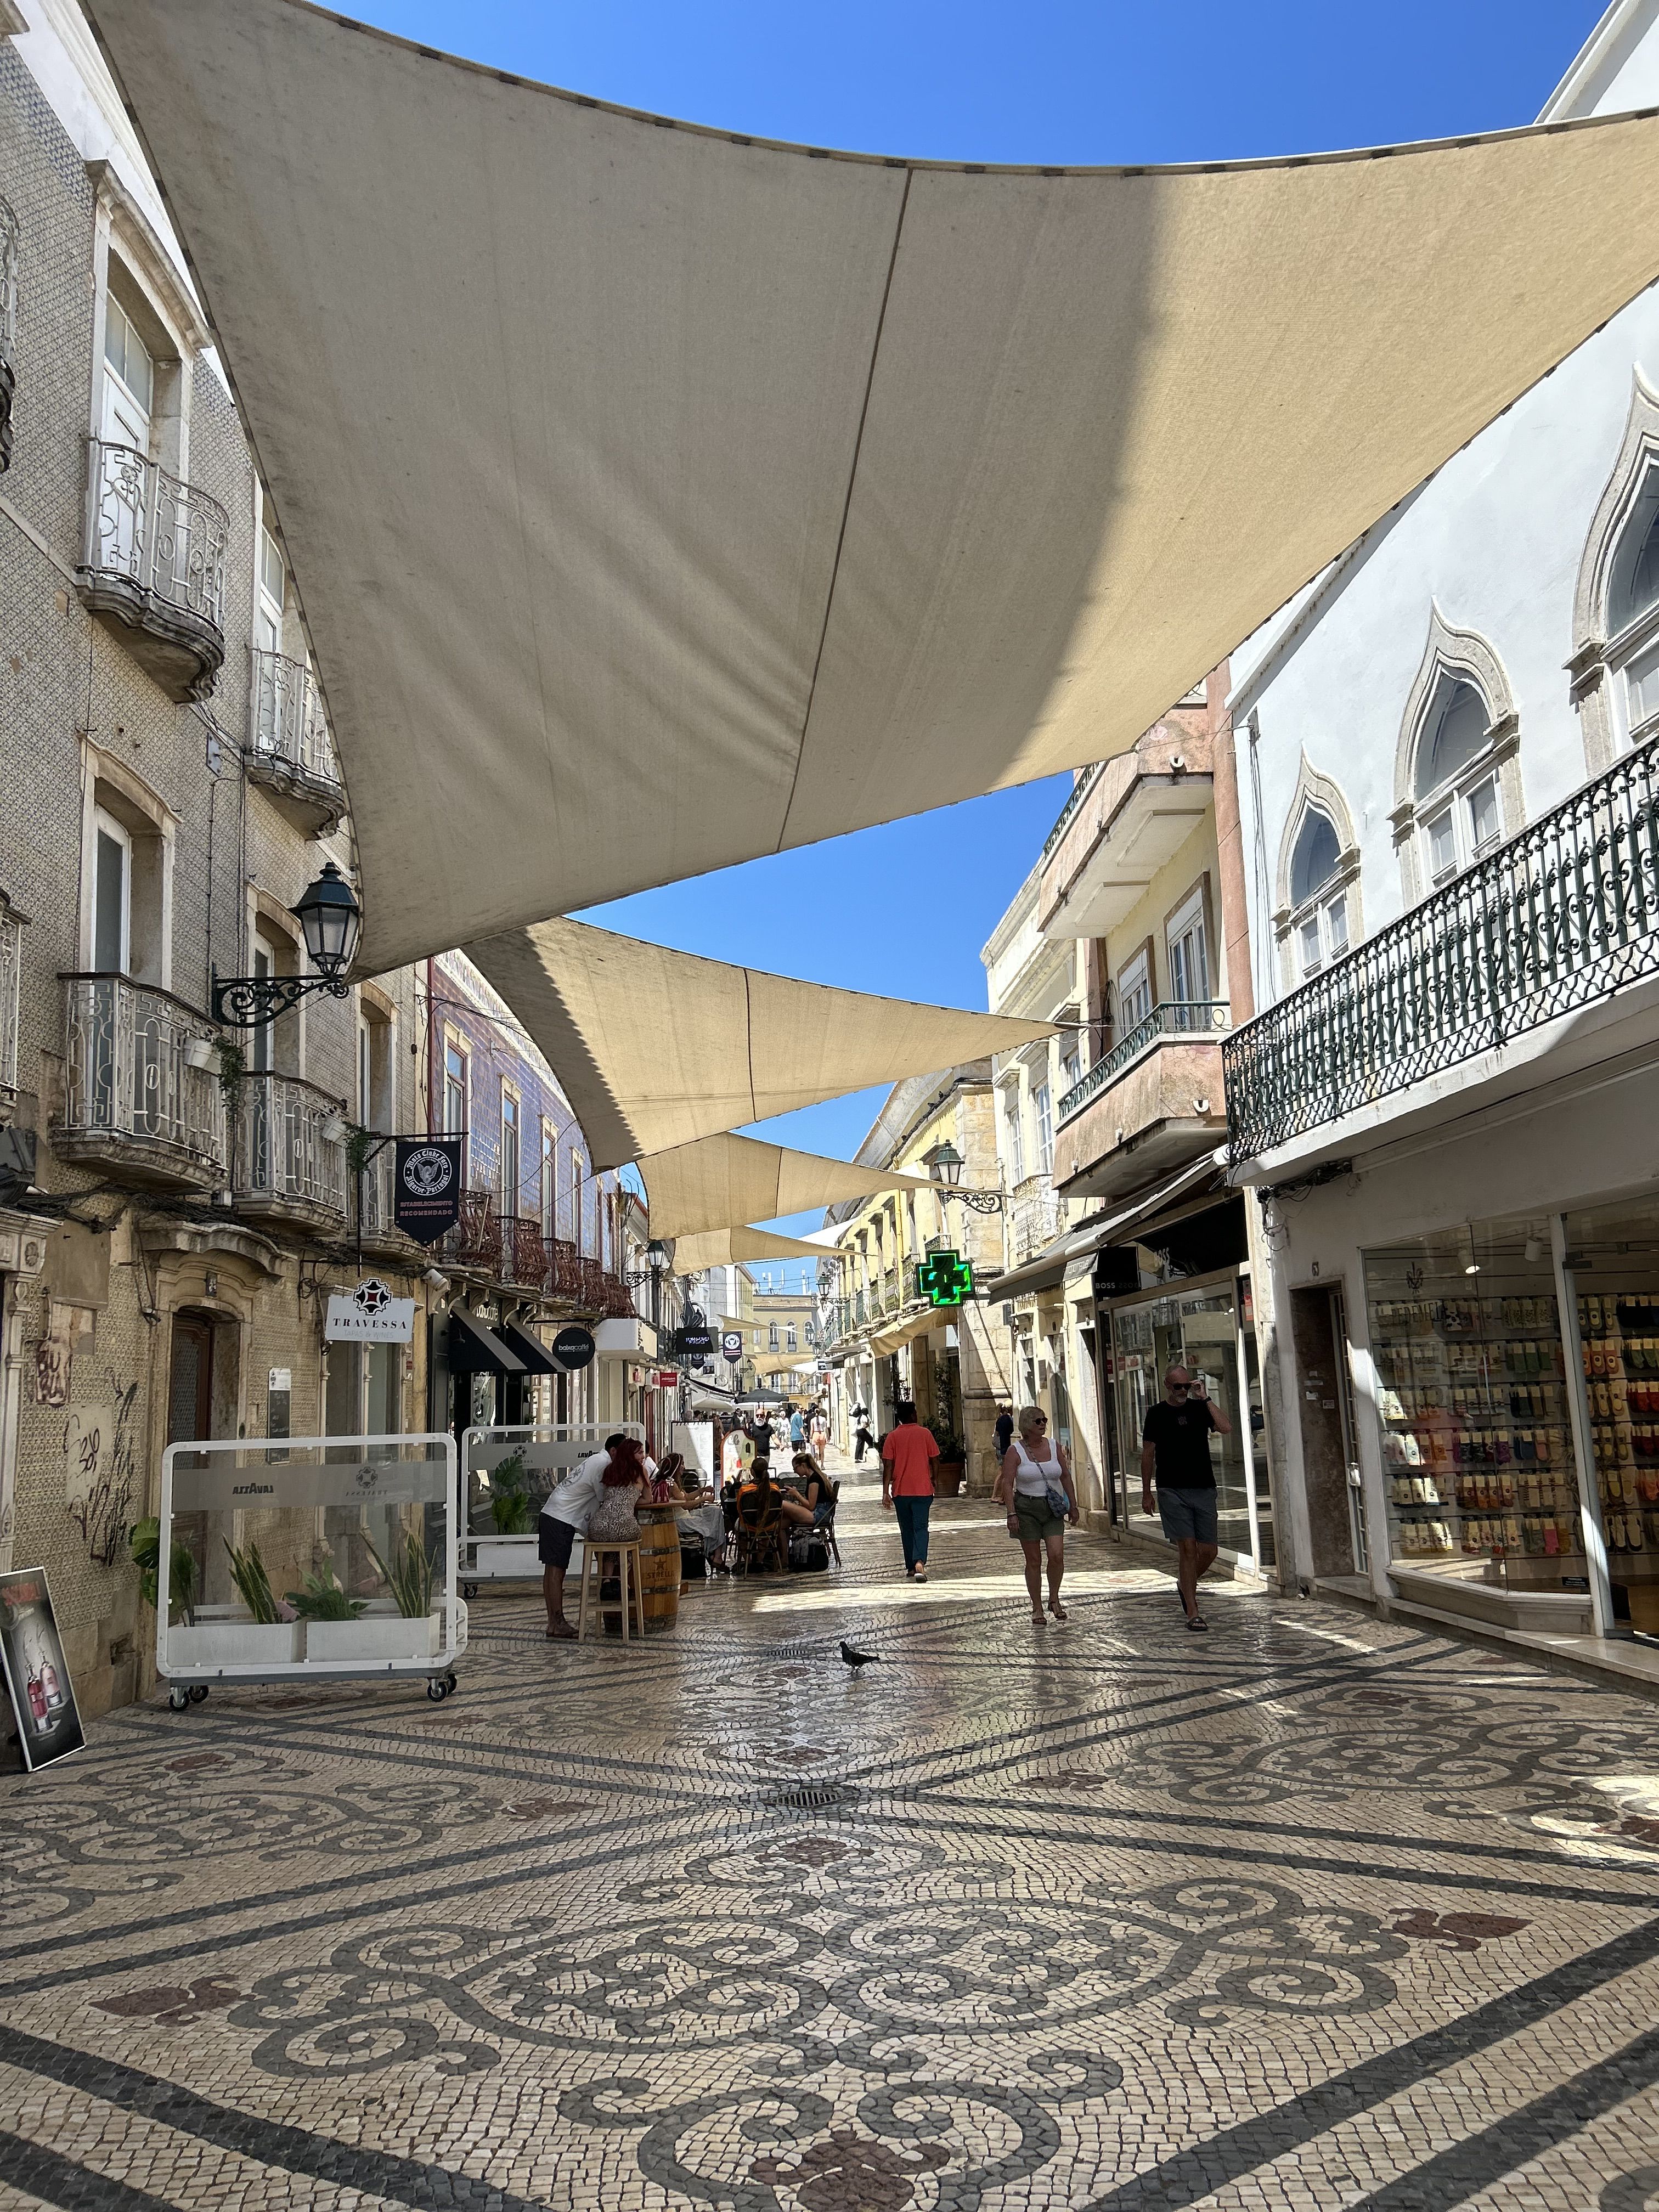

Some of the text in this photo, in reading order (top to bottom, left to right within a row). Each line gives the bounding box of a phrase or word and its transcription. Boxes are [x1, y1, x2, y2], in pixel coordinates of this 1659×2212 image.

[422, 1150, 439, 1158] Clube
[1154, 1247, 1170, 1267] BOSS
[333, 1318, 407, 1329] TRAVESSA
